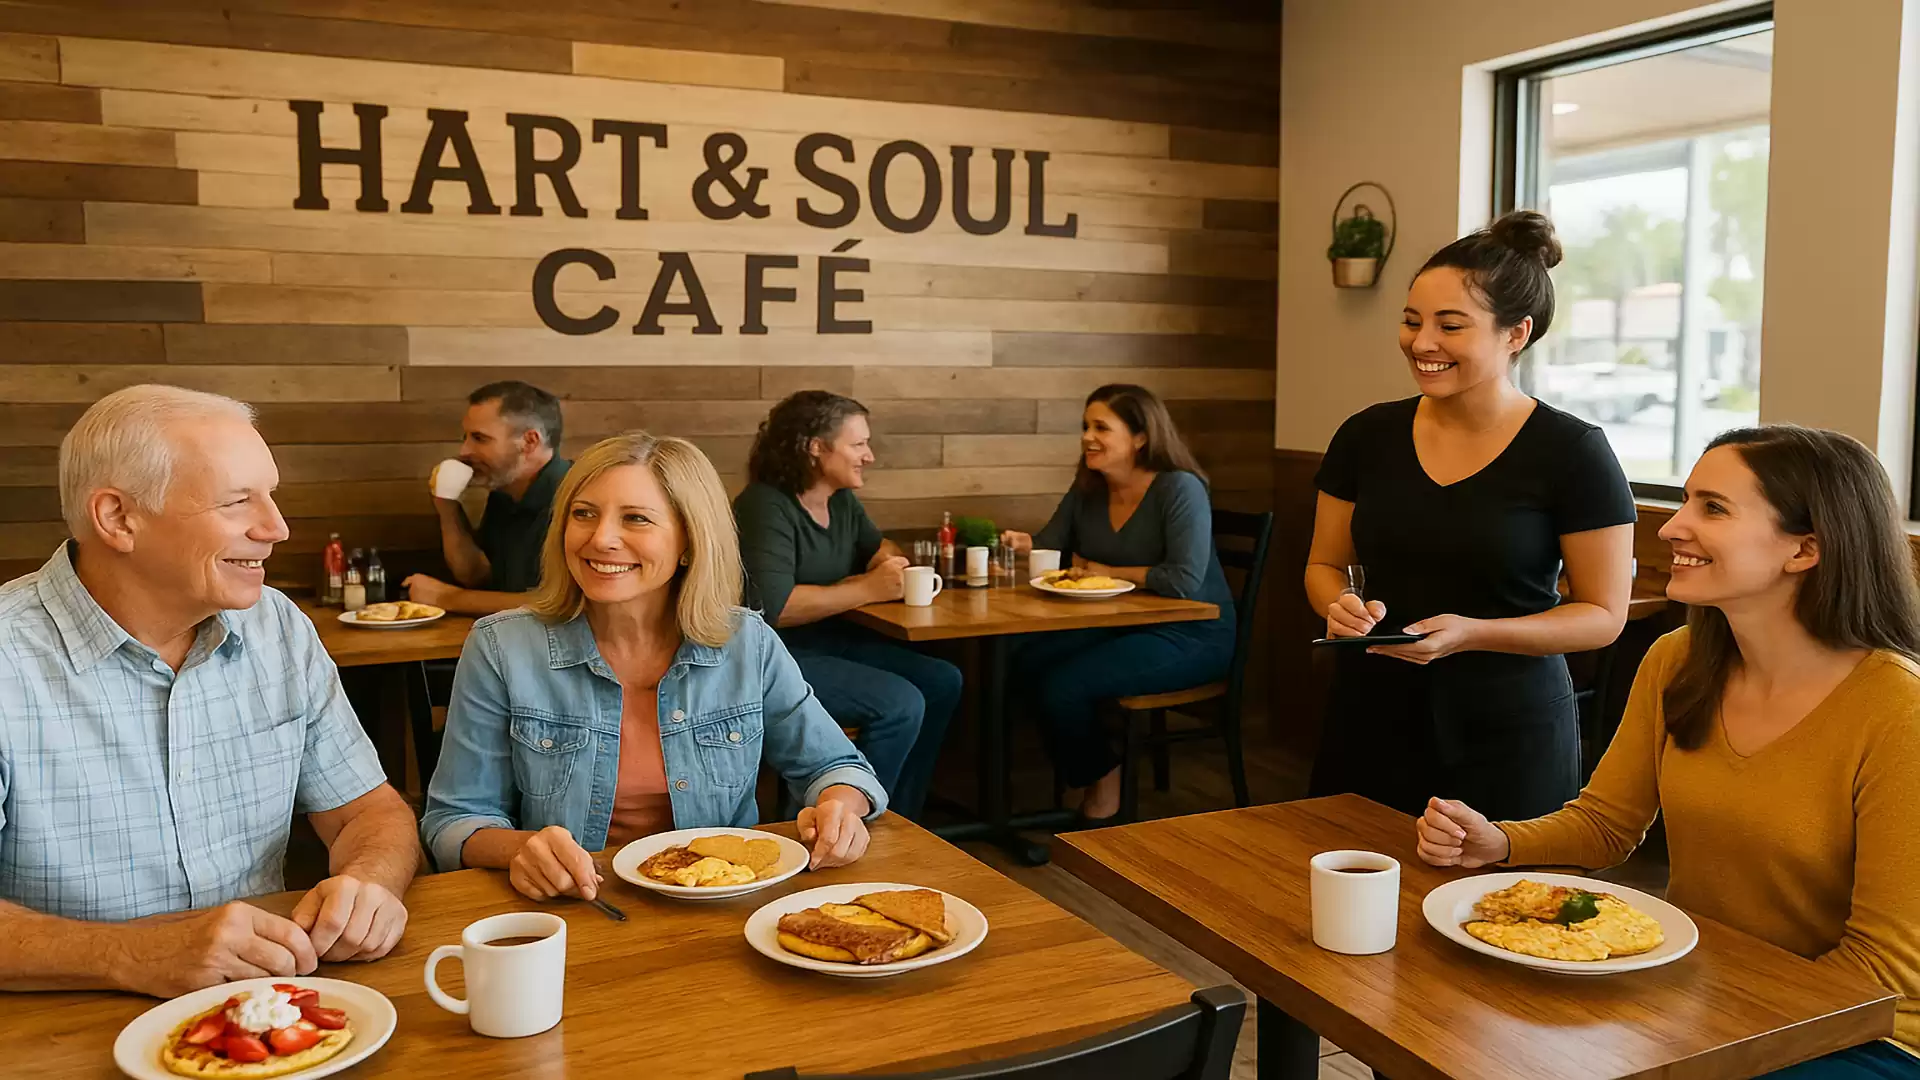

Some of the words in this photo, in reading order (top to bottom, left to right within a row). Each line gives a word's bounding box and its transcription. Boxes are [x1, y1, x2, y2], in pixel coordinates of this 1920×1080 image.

[289, 100, 668, 220] HART
[692, 132, 770, 220] &
[794, 133, 1078, 239] SOUL
[532, 239, 873, 336] CAFÉ
